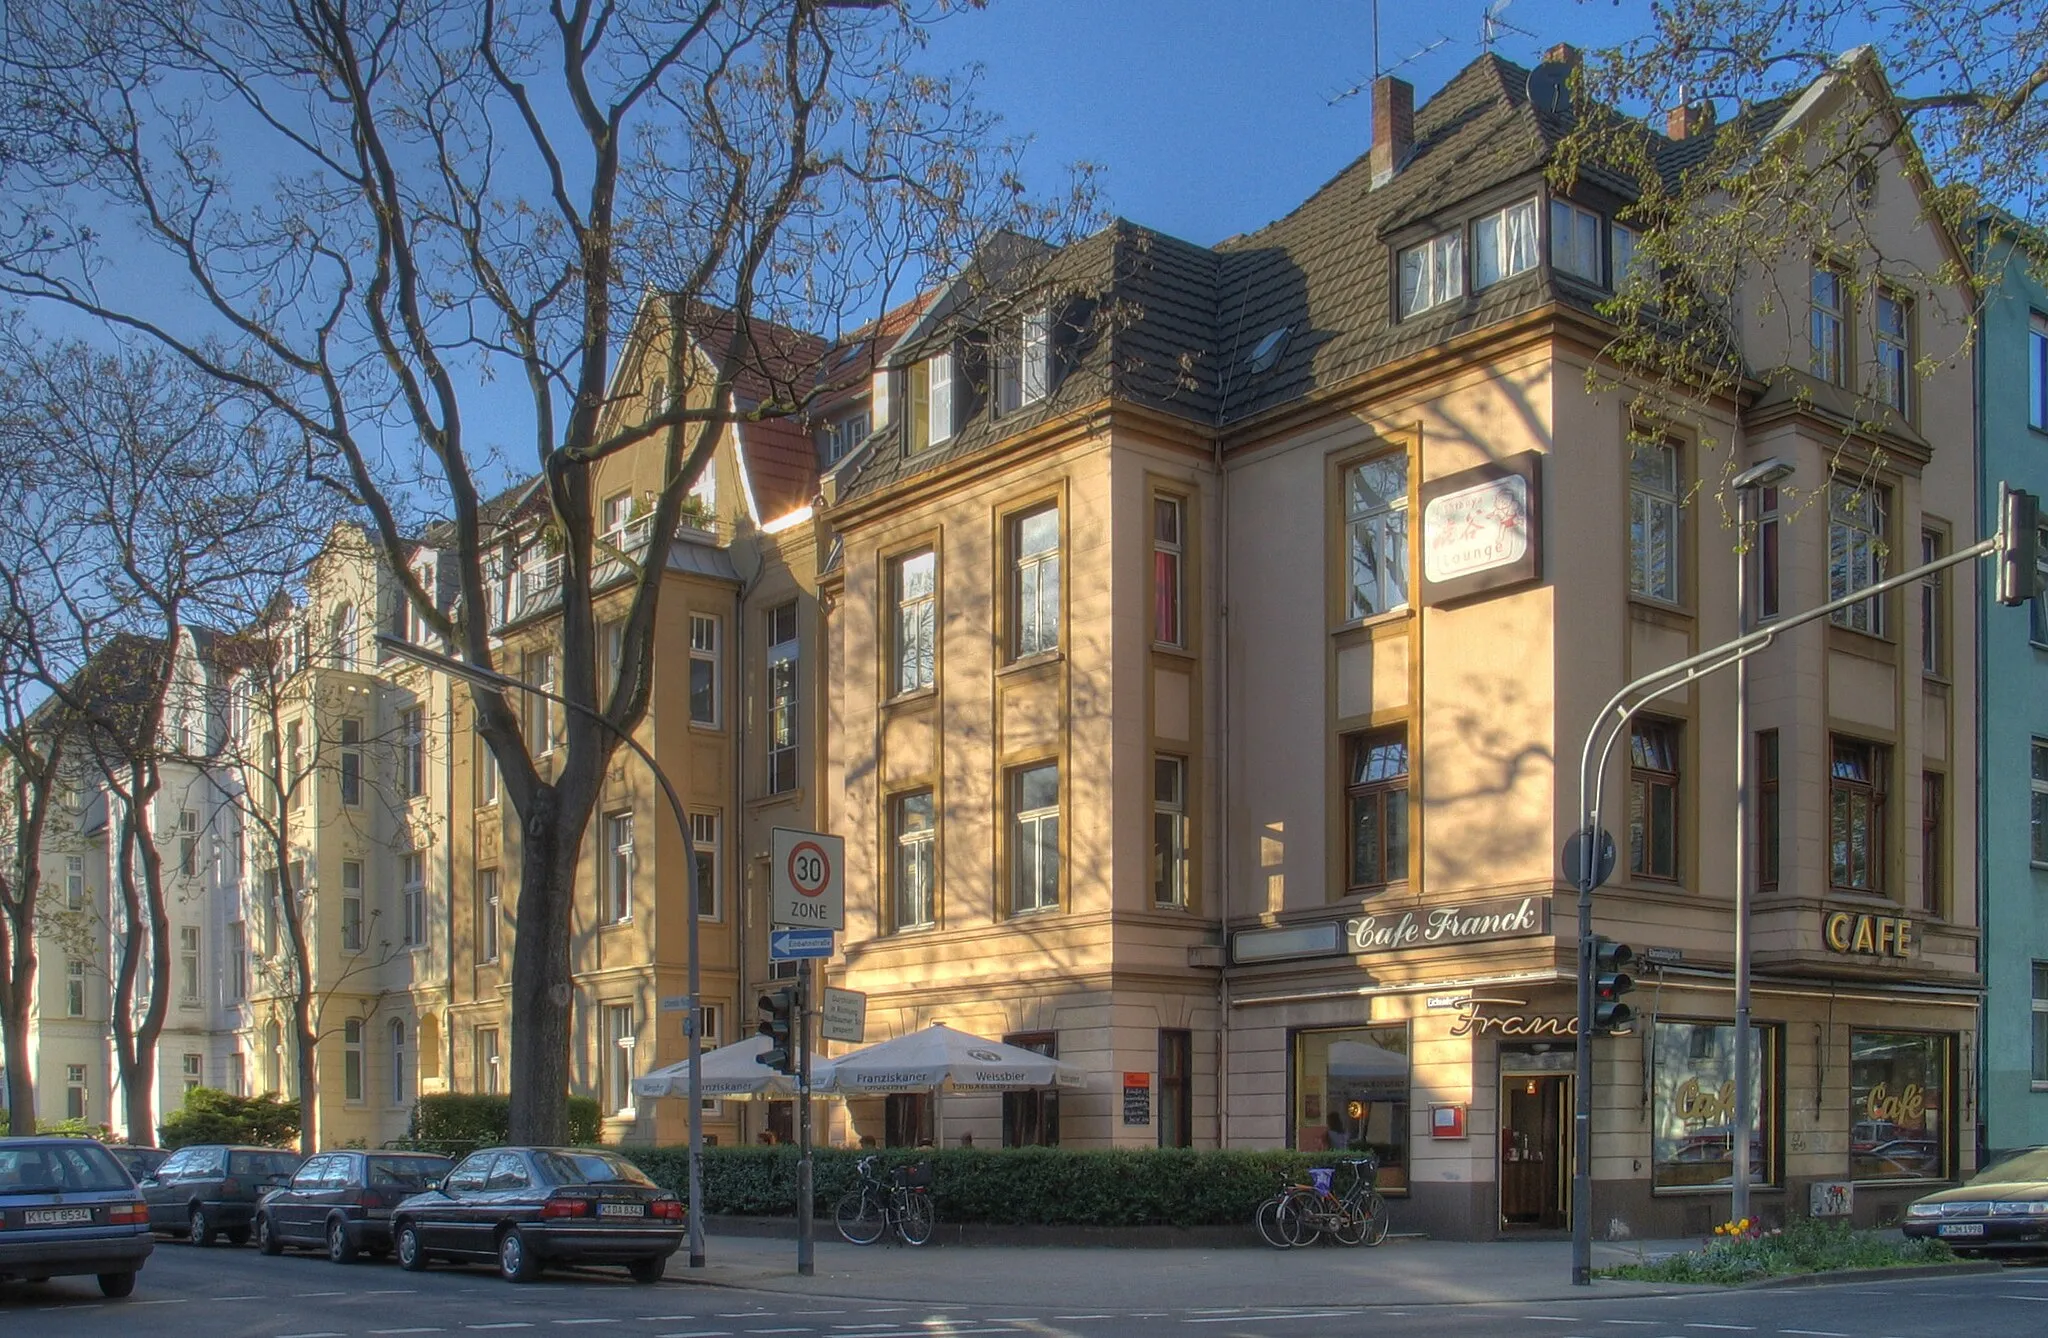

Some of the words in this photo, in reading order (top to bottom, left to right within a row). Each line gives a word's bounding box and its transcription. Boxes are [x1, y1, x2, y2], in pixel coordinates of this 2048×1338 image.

[797, 856, 820, 882] 30
[791, 901, 828, 919] ZONE
[1345, 912, 1419, 949] Cafe
[1424, 897, 1535, 942] Franck
[1823, 911, 1912, 957] CAFE
[1451, 998, 1632, 1036] Franc
[857, 1073, 927, 1083] Franziskaner
[976, 1072, 1026, 1082] Weissbier
[1676, 1077, 1736, 1122] Caf
[1867, 1081, 1925, 1126] Café
[28, 1212, 36, 1222] K
[43, 1211, 57, 1221] CT
[61, 1210, 88, 1220] 8534
